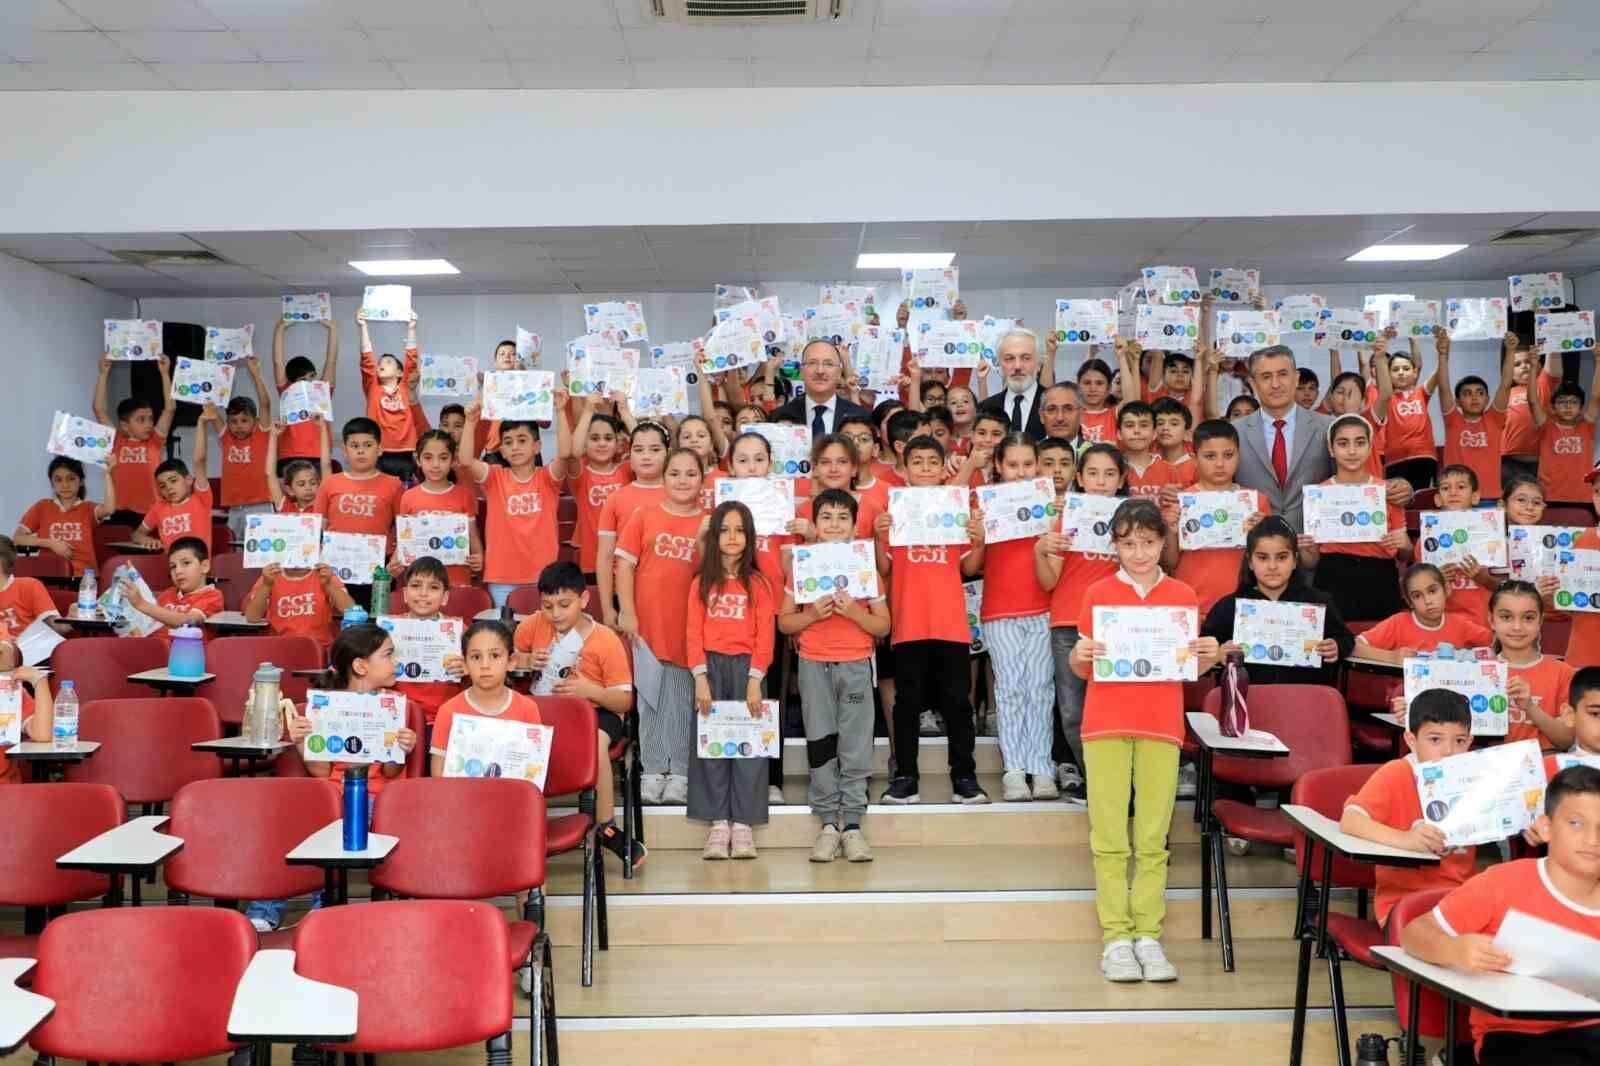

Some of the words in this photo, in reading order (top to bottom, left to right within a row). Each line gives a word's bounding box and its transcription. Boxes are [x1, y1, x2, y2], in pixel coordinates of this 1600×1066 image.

[338, 494, 377, 517] CSI
[508, 492, 542, 516] CSI
[49, 522, 82, 541] CSI
[161, 513, 192, 536] CSI
[655, 532, 696, 561] CSI
[278, 593, 316, 618] CSI
[707, 593, 748, 619] CSI
